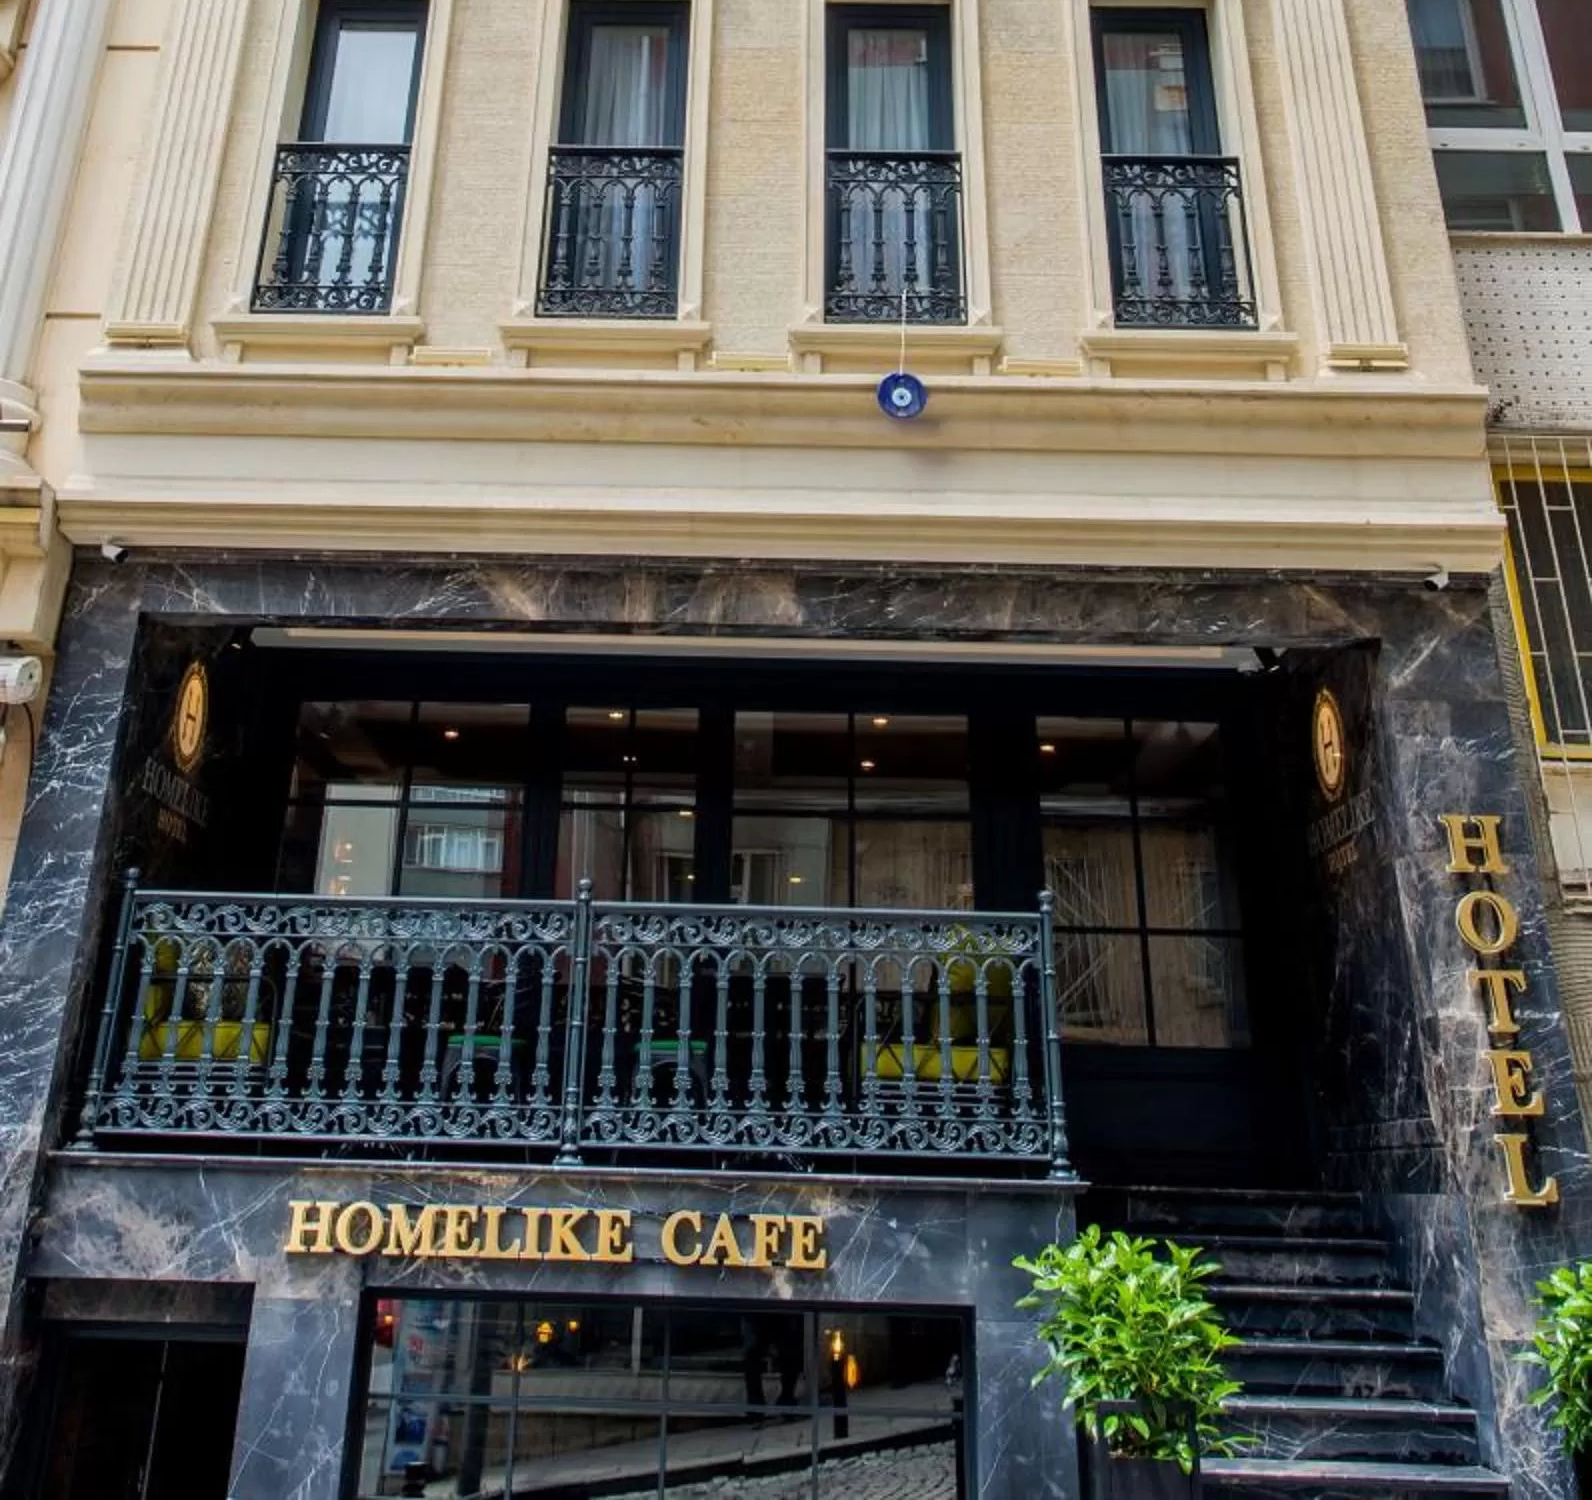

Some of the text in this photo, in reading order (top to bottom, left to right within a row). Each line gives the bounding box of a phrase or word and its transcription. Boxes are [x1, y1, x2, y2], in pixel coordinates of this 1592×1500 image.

[1439, 814, 1558, 1206] HOTEL
[284, 1200, 827, 1269] HOMELIKE CAFE
